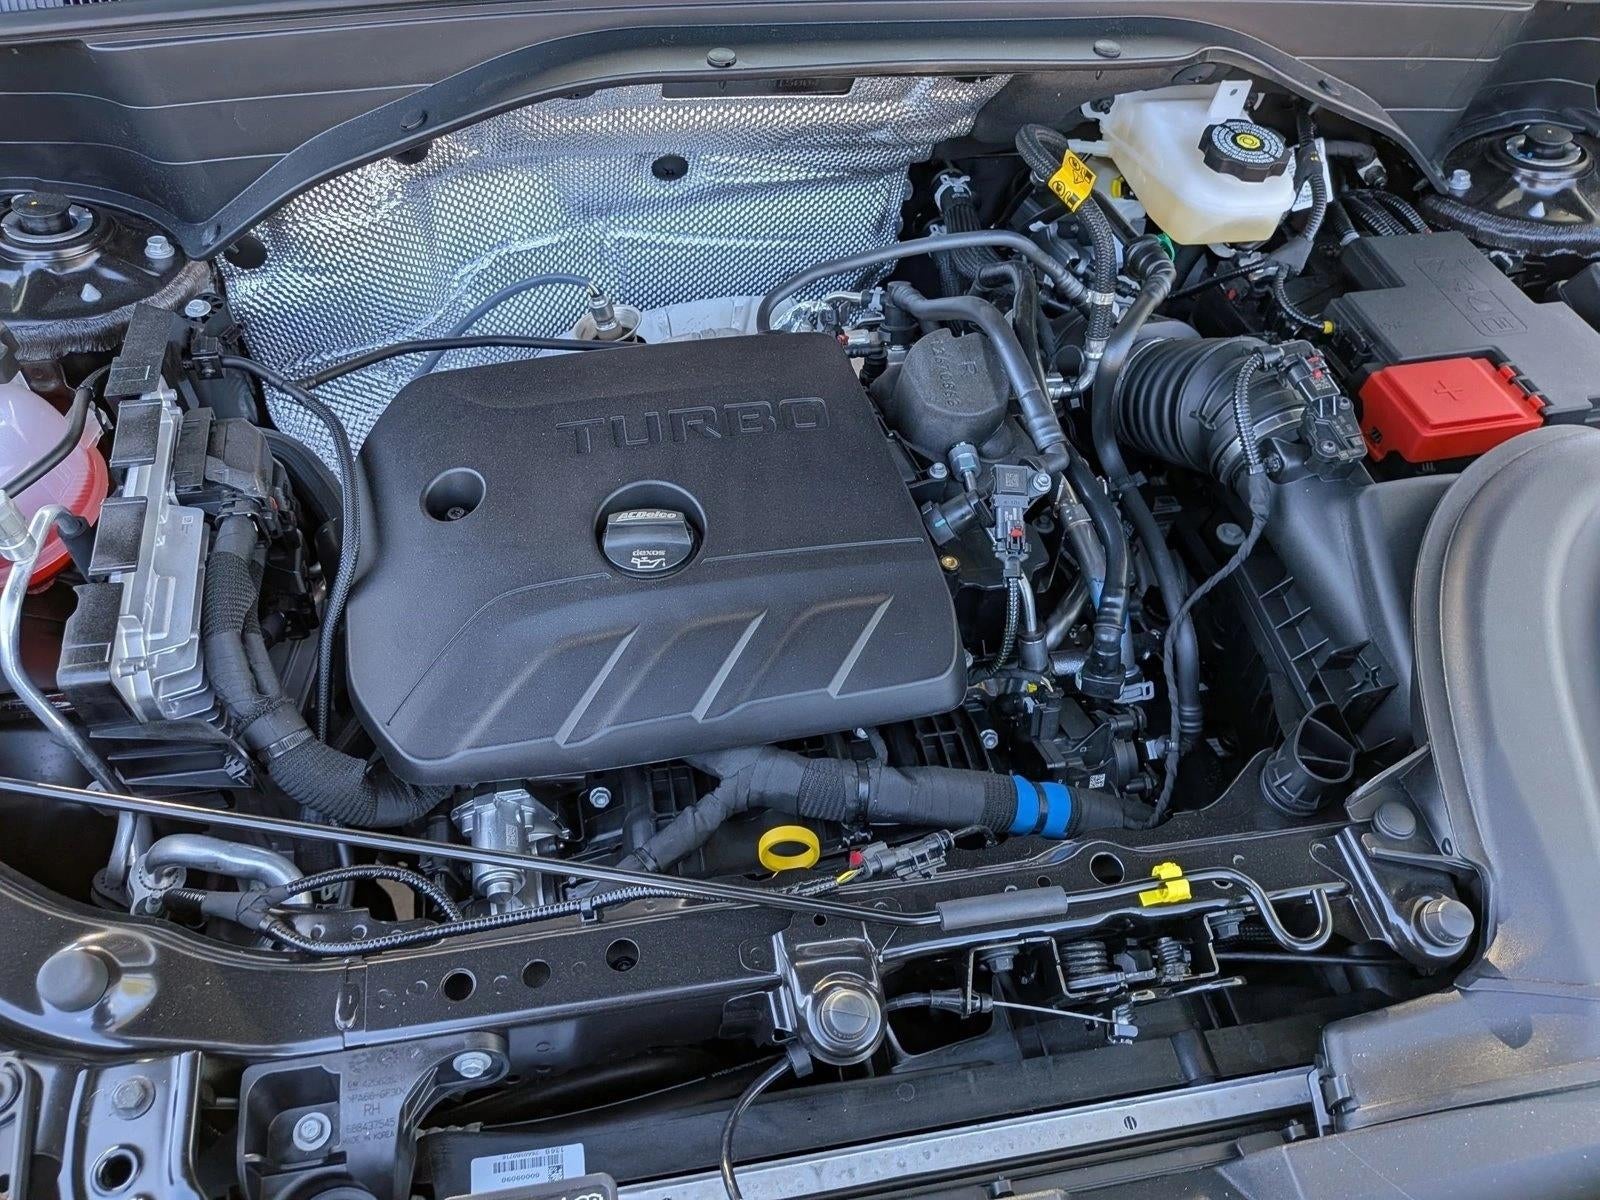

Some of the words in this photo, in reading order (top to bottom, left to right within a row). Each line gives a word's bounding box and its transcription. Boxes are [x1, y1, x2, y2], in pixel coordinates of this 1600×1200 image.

[555, 396, 831, 454] TURBO
[616, 511, 677, 522] ACDelco
[364, 1102, 380, 1116] RH
